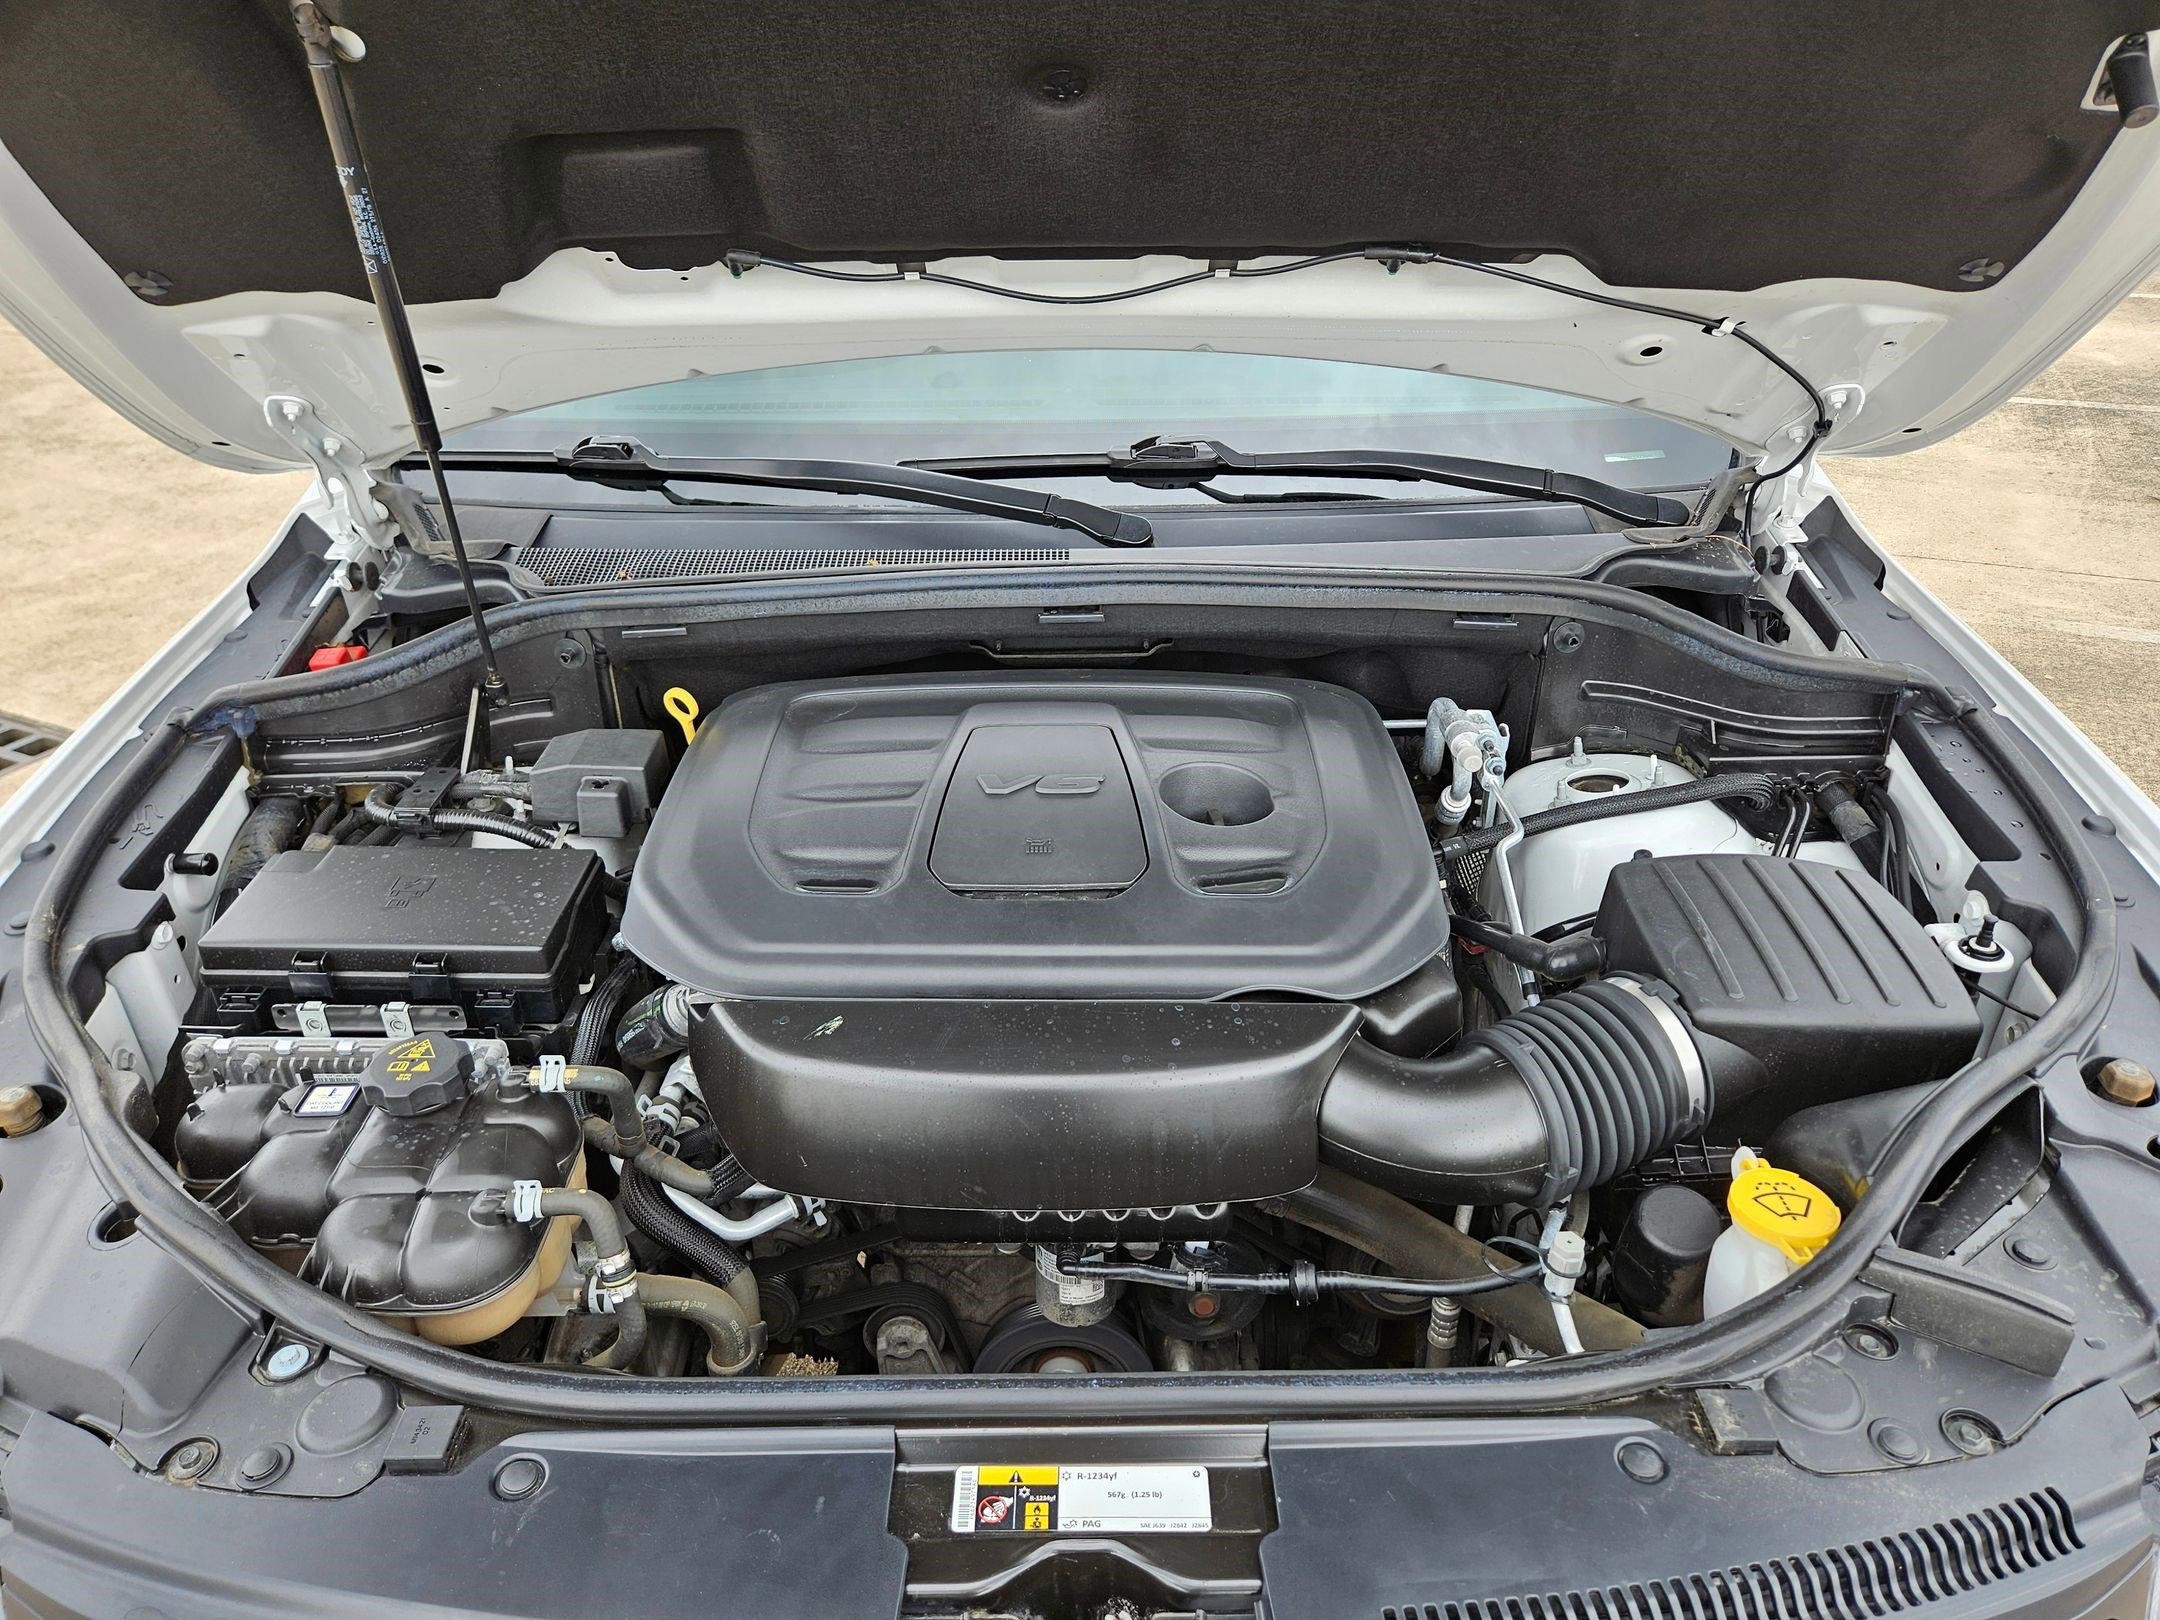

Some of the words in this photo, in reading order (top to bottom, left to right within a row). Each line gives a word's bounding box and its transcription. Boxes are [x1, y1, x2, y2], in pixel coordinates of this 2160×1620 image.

[976, 774, 1106, 795] V6
[1077, 1472, 1117, 1481] R-1234yf
[1107, 1491, 1126, 1499] 567g
[1131, 1491, 1151, 1499] (1.25
[1152, 1491, 1162, 1499] lb)
[1082, 1520, 1101, 1528] PAG
